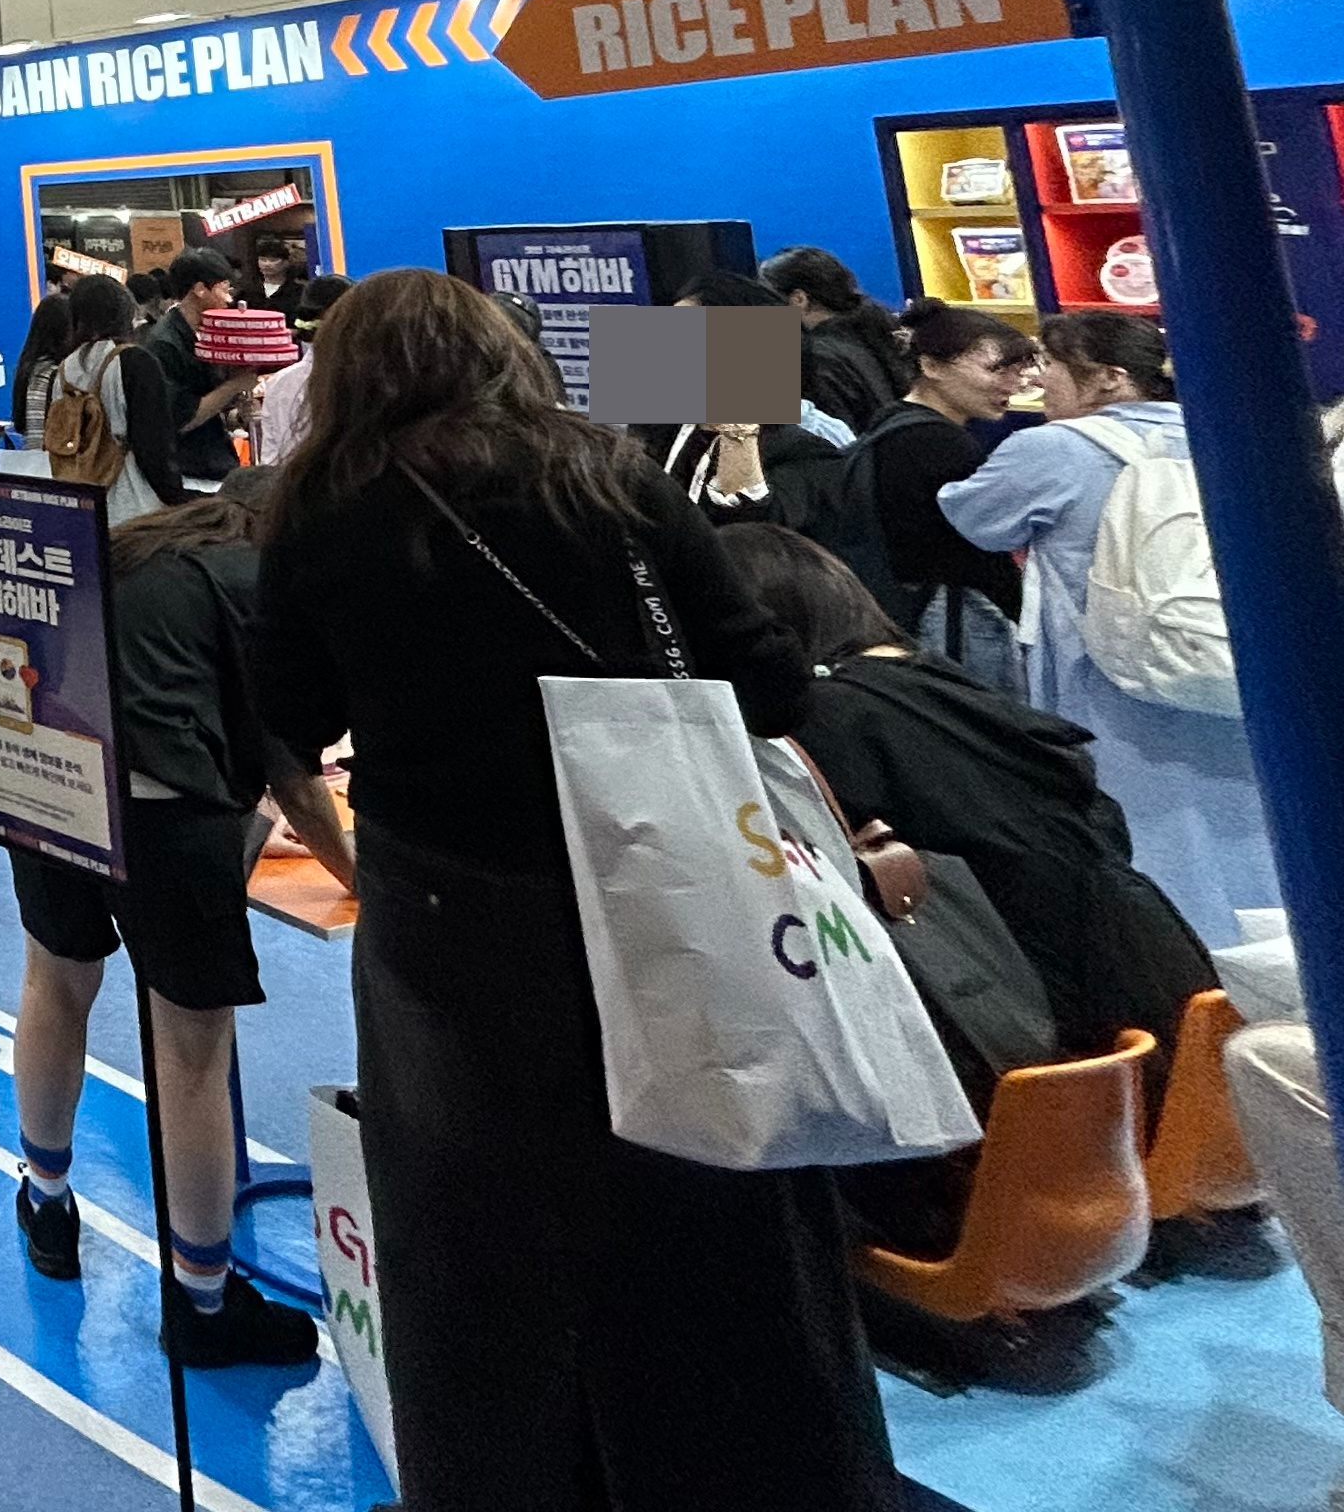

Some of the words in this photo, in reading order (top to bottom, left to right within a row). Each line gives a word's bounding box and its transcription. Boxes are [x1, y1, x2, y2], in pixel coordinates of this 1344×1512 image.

[87, 40, 191, 107] RICE
[192, 20, 324, 93] PLAN
[211, 186, 294, 232] HETBAHN
[491, 256, 634, 294] GYM해바
